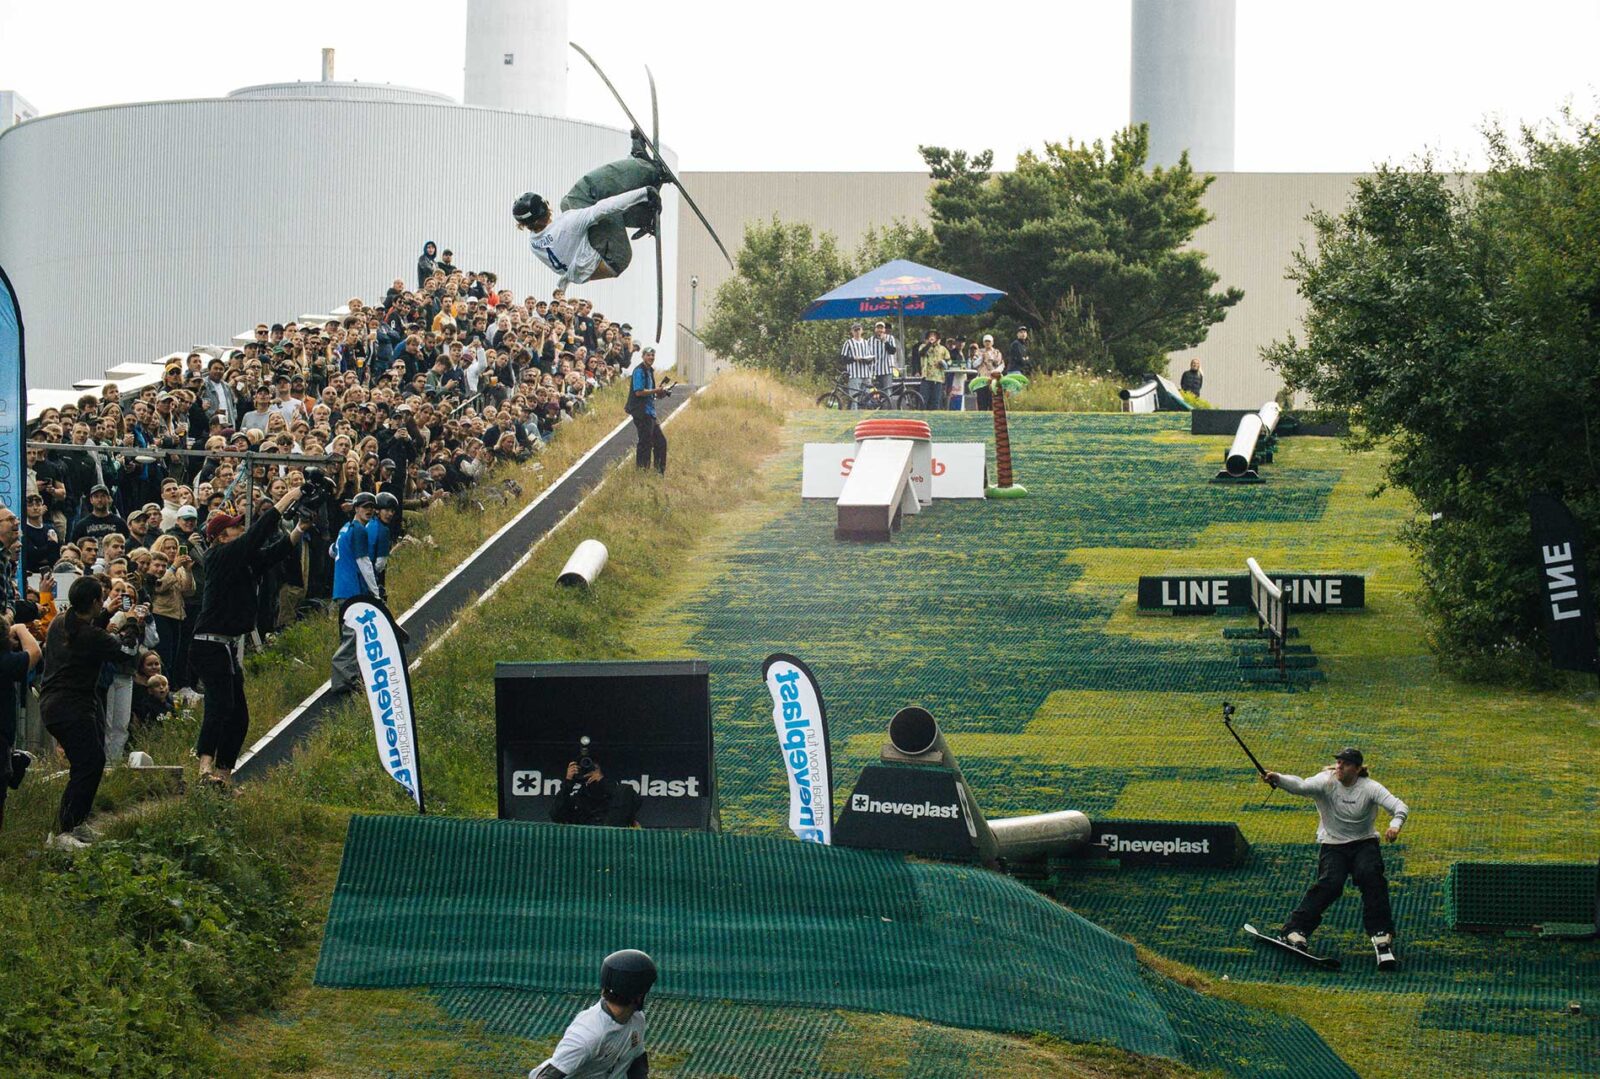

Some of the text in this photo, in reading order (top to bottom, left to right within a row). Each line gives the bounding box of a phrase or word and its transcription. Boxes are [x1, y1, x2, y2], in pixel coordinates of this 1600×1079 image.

[1161, 580, 1229, 606] LINE
[544, 774, 699, 797] nlast
[869, 801, 959, 819] neveplast
[1119, 837, 1209, 856] neveplast
